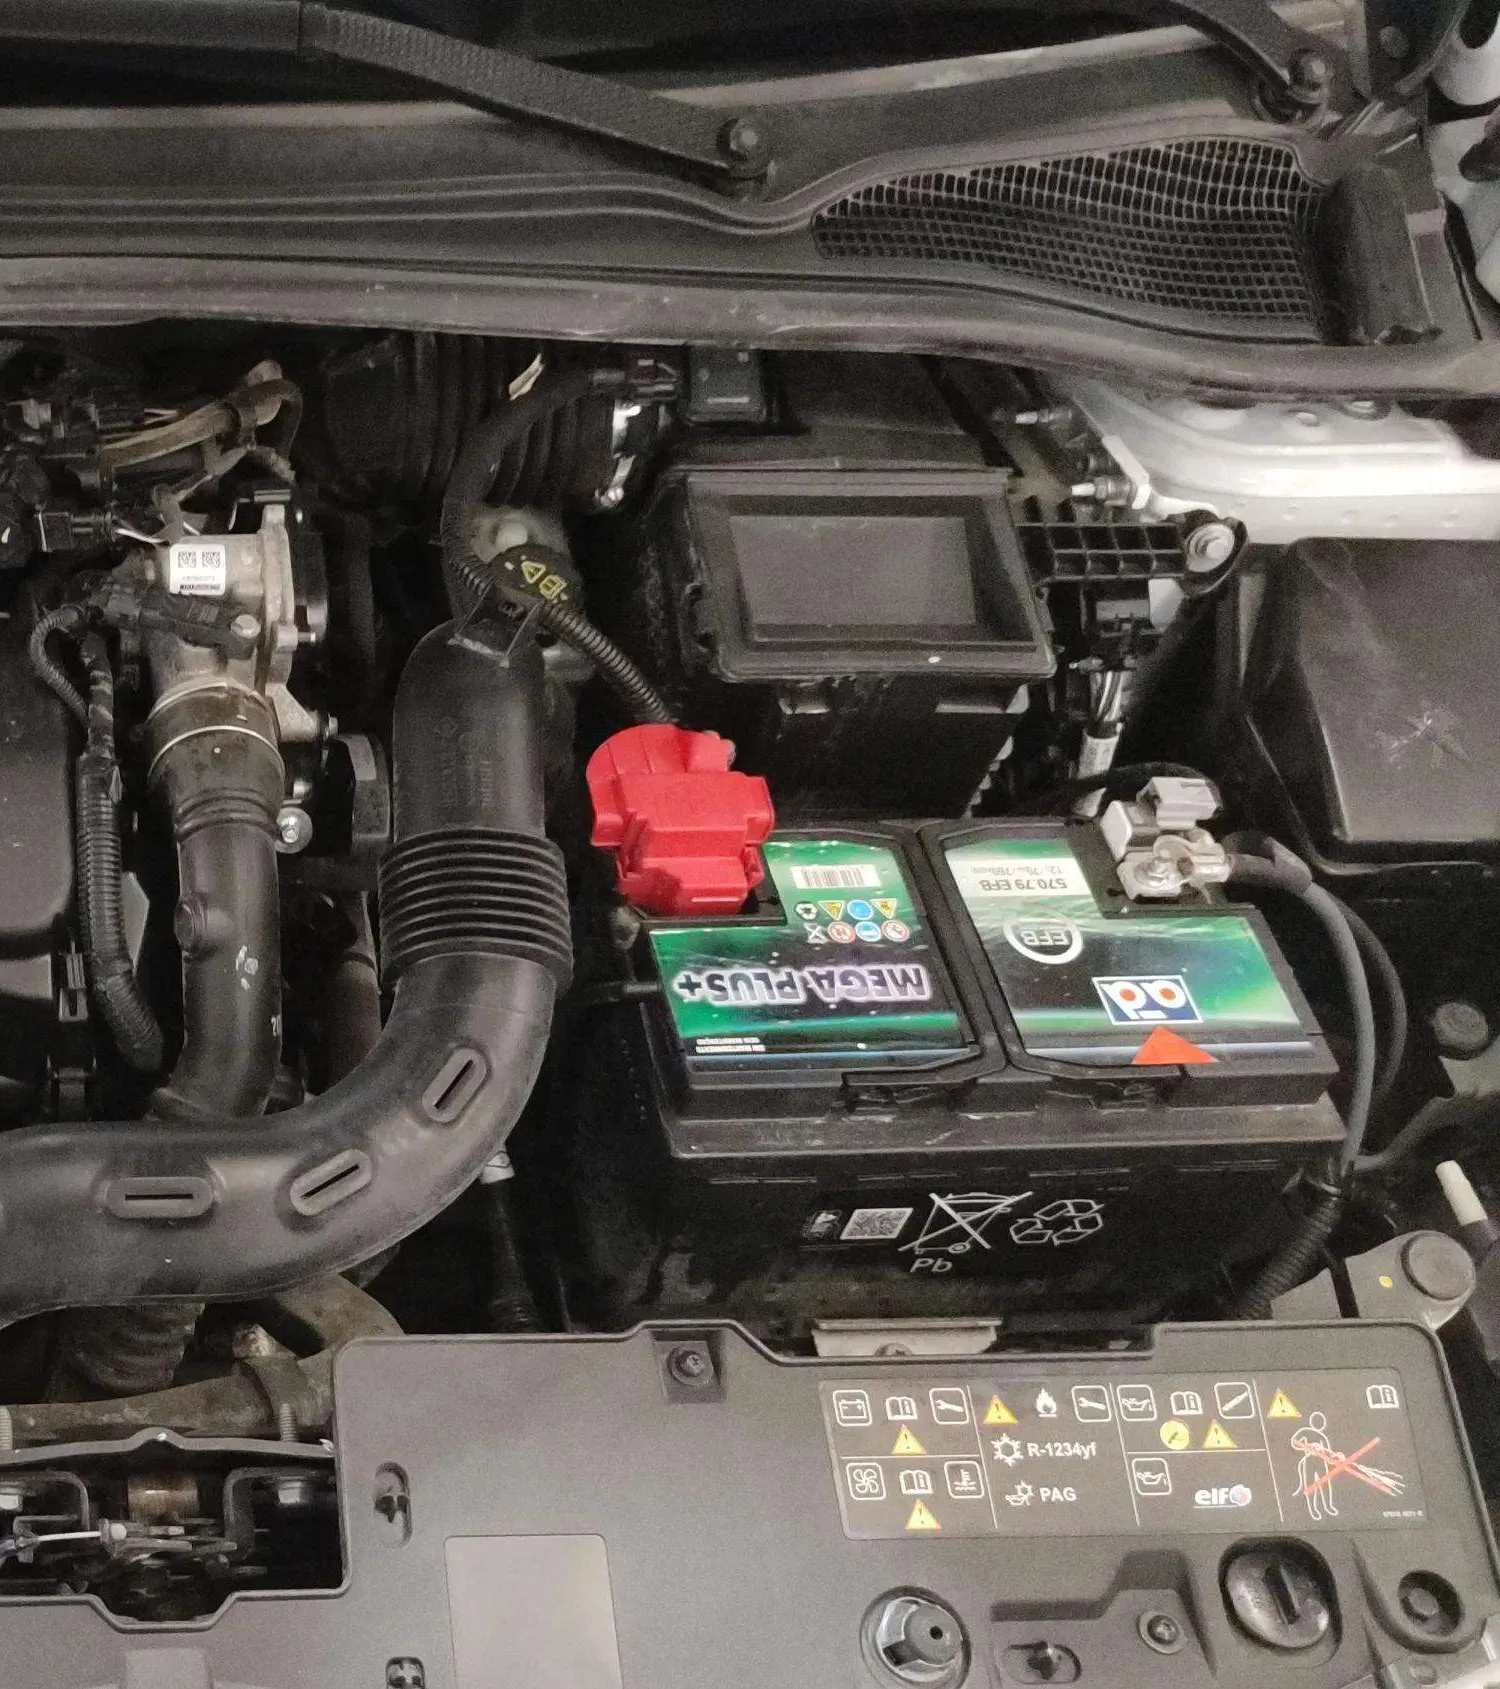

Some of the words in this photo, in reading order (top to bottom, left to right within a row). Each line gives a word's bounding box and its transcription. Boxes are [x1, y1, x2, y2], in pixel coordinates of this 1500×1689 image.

[980, 878, 1013, 892] EFB
[1020, 929, 1070, 946] EFB
[910, 1257, 953, 1273] Pb
[1027, 1442, 1097, 1460] R-1234yf
[1040, 1486, 1077, 1502] PAG
